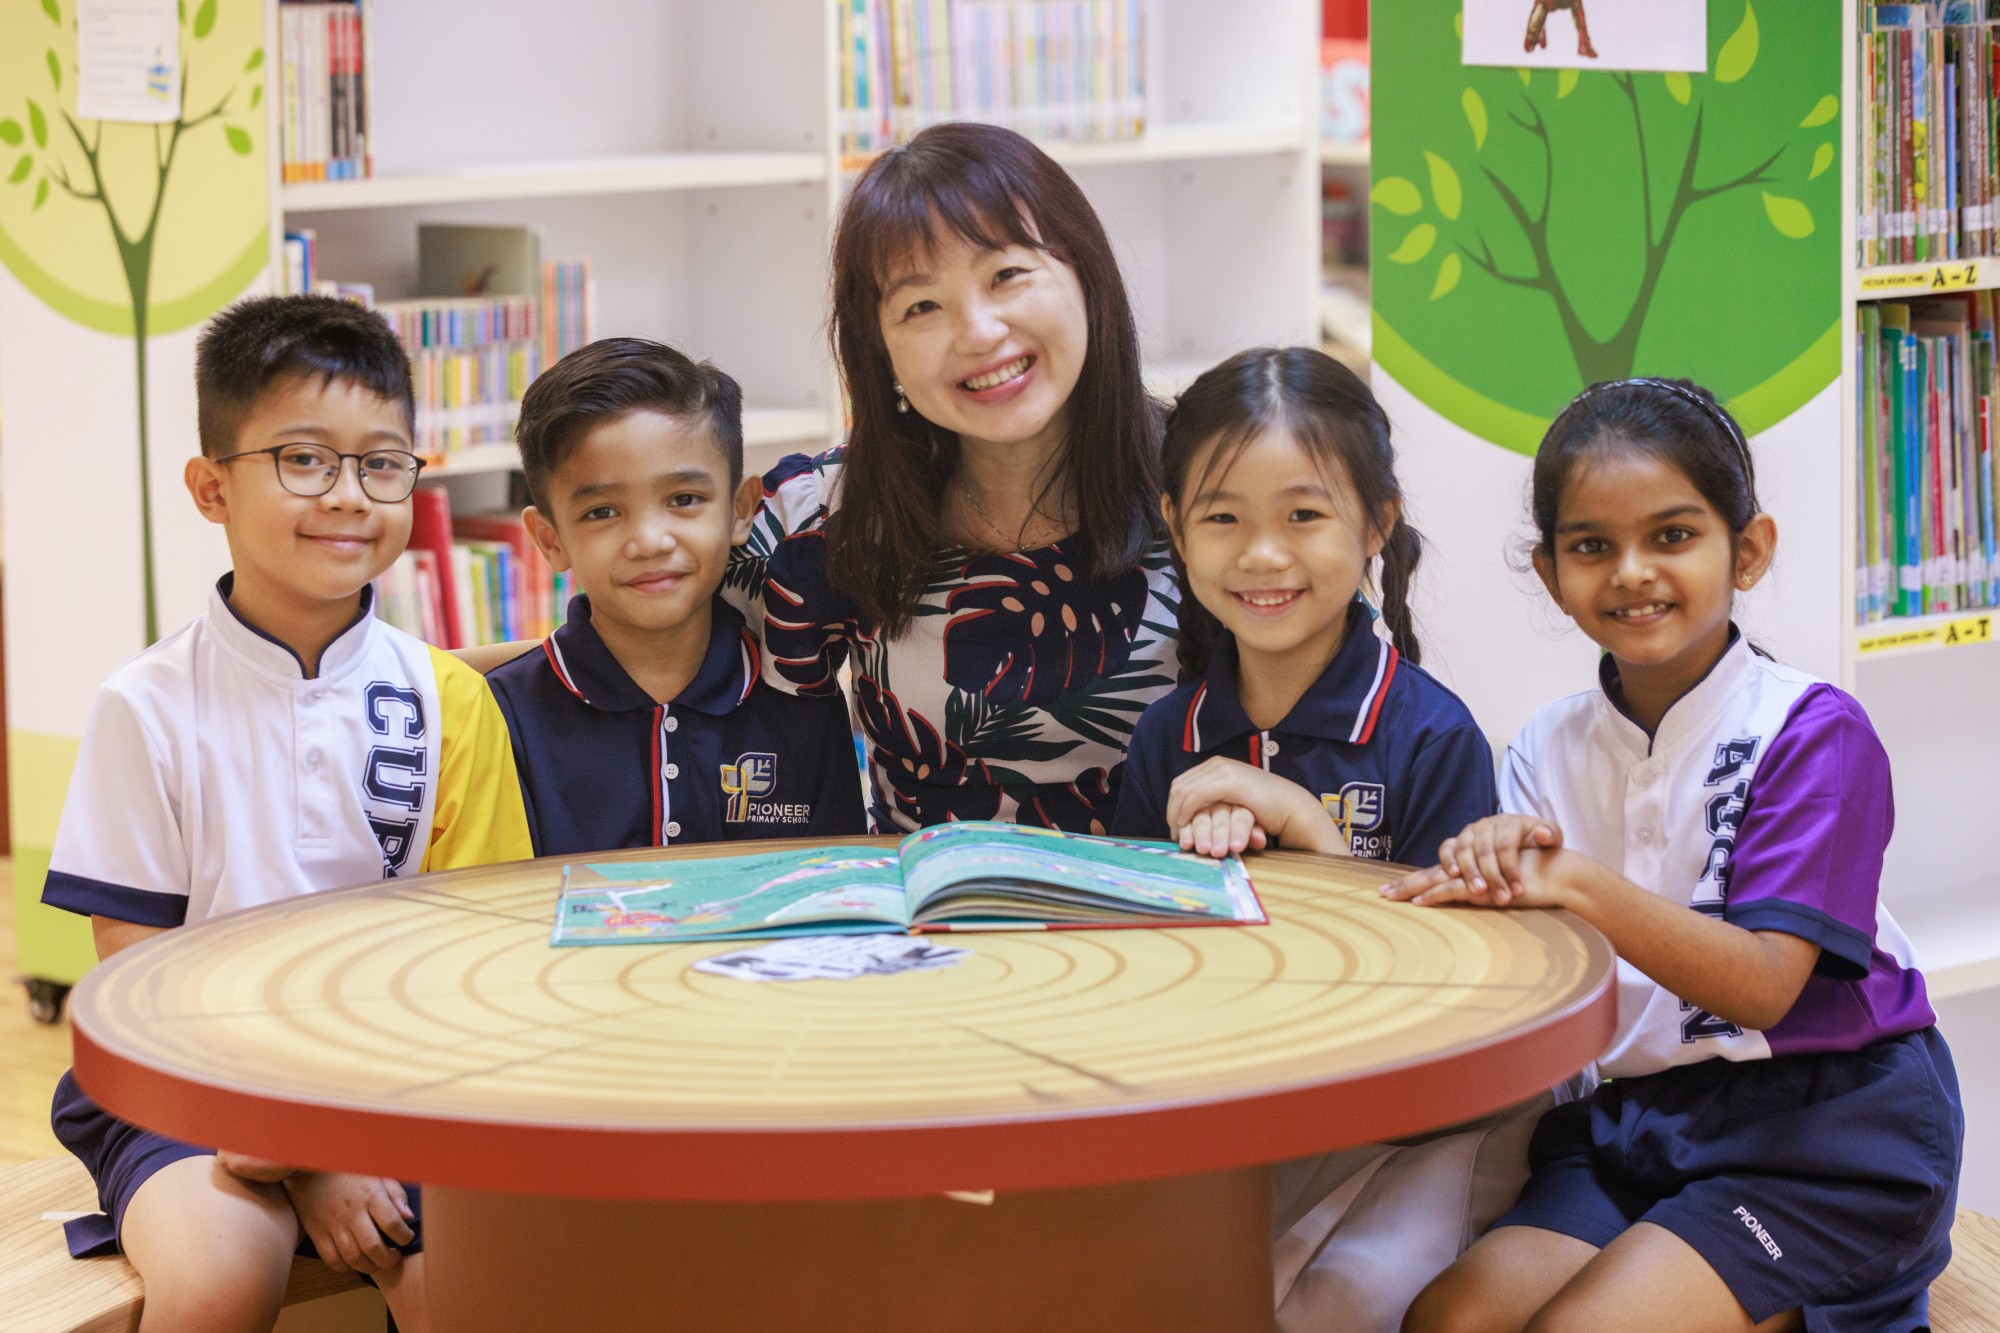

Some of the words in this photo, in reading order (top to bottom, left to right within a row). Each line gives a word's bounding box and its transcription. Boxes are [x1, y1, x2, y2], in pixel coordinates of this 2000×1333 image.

[748, 803, 810, 816] PIONEER
[746, 815, 780, 824] PRIMARY
[781, 816, 810, 824] SCHOOL
[1732, 1205, 1783, 1261] PIONEER
